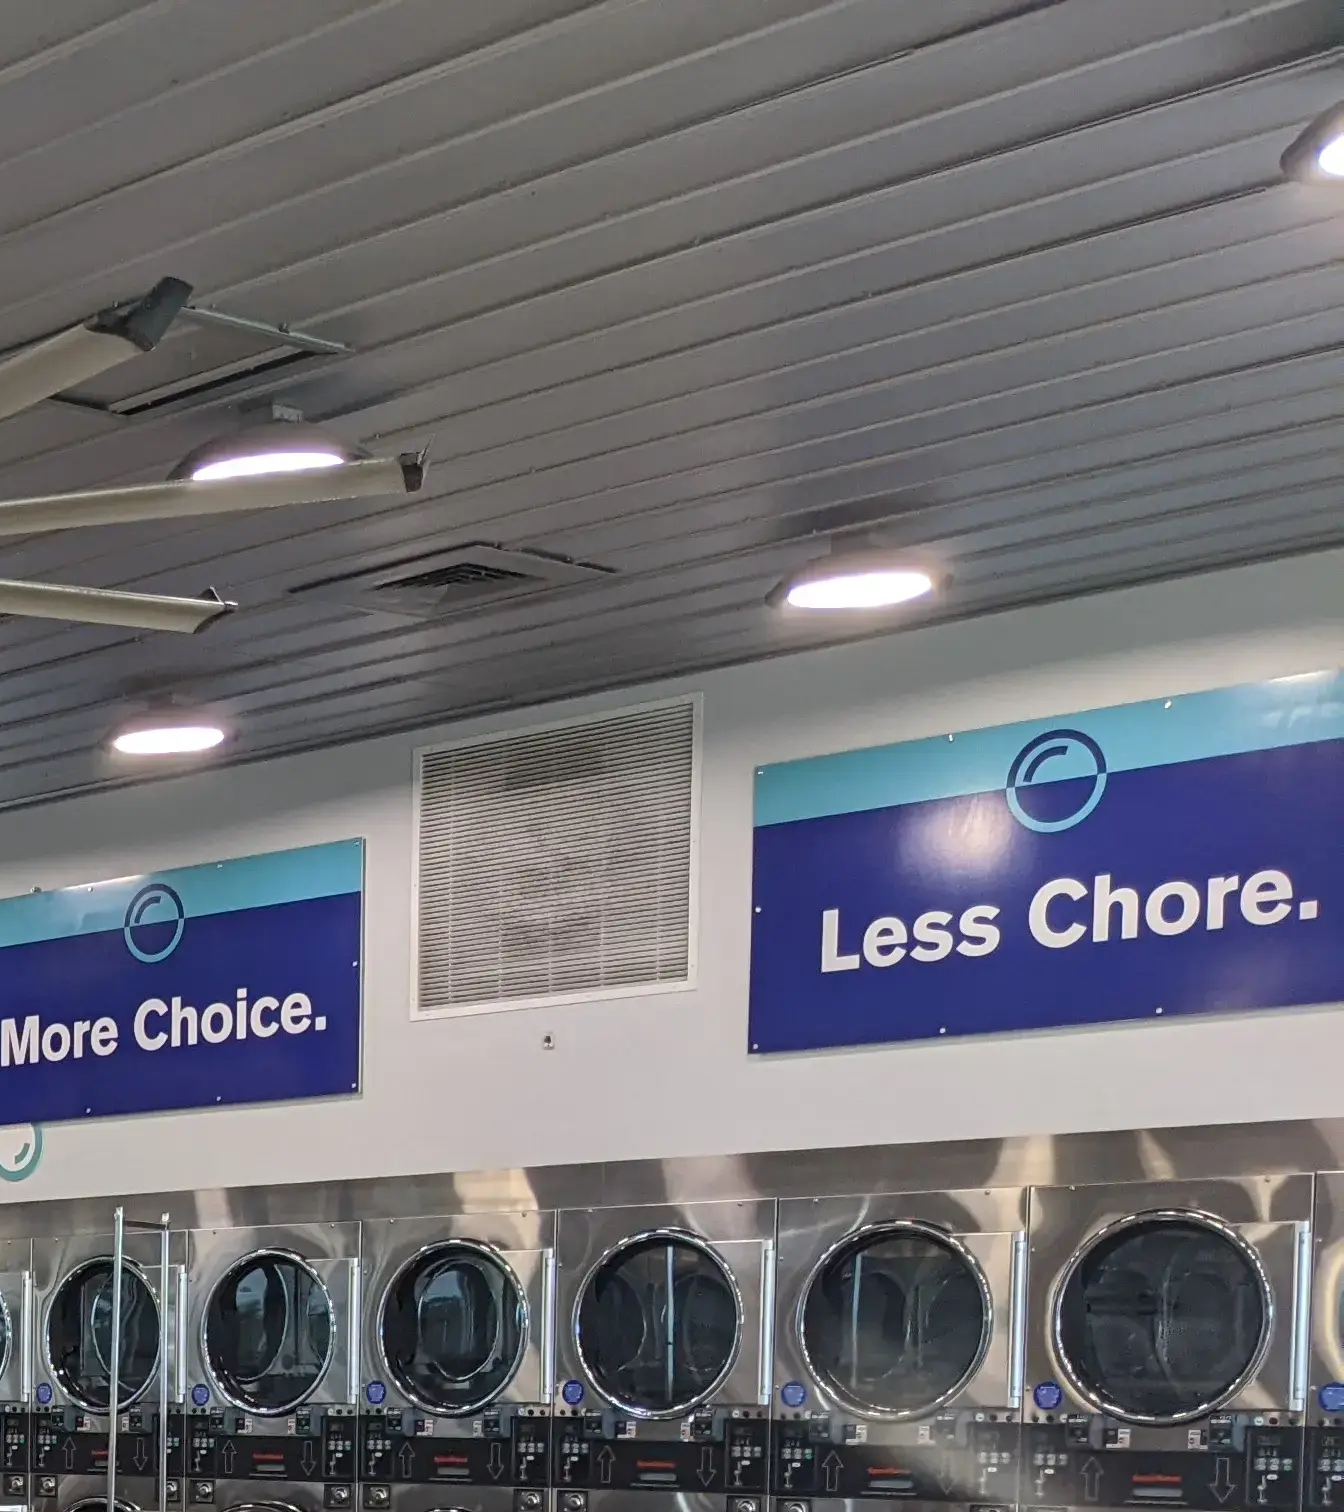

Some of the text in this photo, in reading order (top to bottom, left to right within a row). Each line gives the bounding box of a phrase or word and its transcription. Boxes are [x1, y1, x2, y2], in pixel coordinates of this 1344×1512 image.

[822, 868, 1318, 973] Less Chore.
[0, 991, 326, 1067] More Choice.
